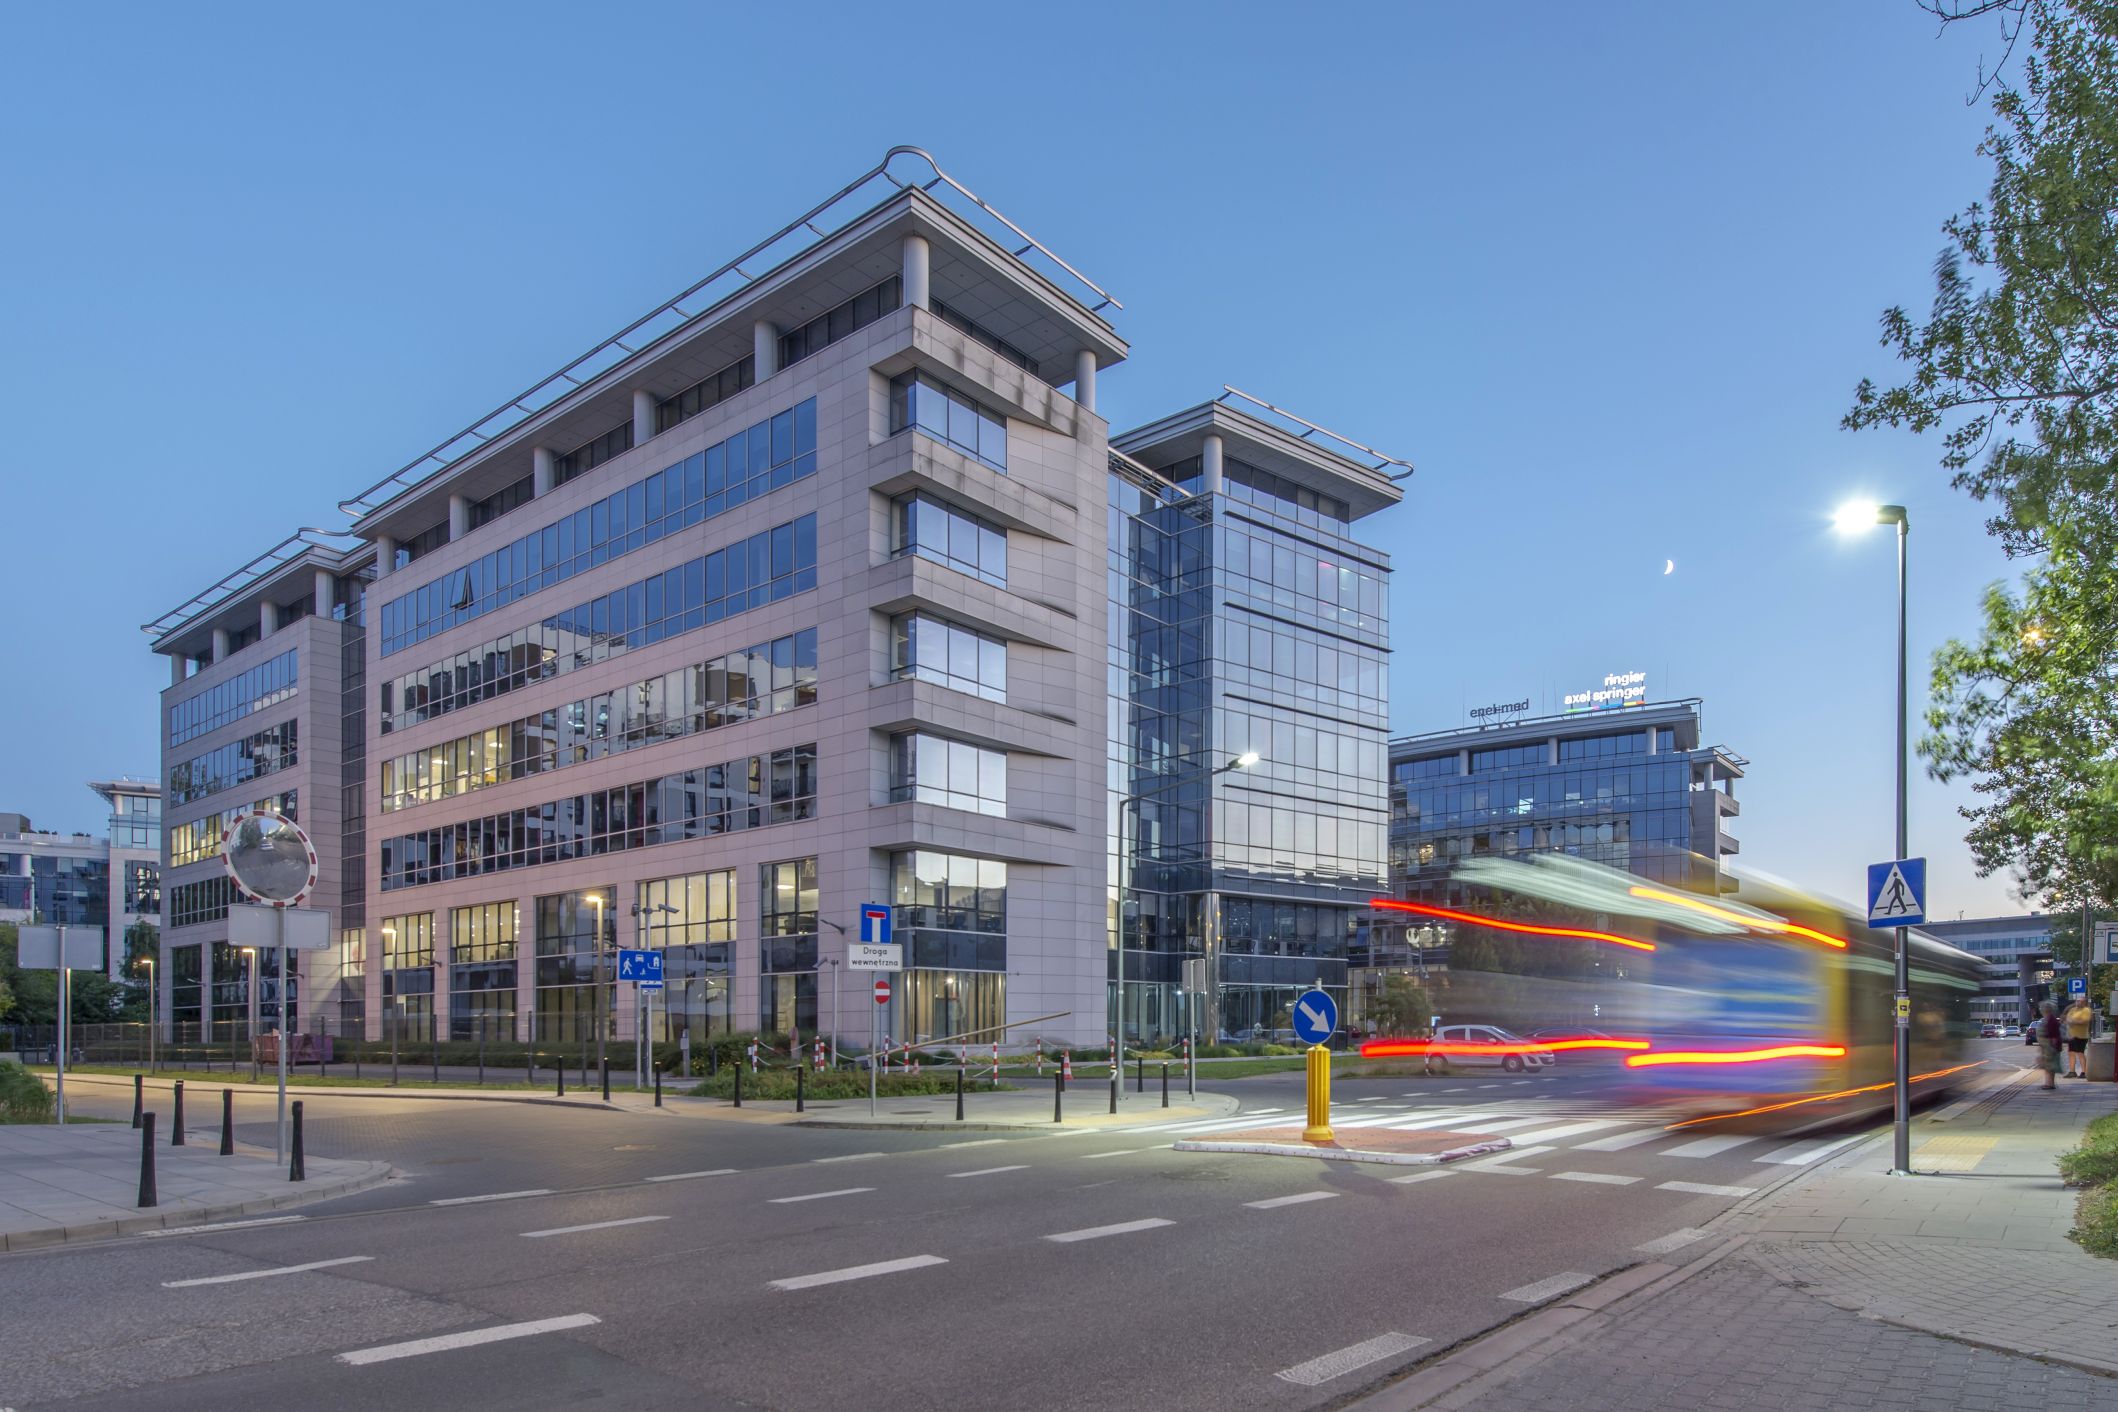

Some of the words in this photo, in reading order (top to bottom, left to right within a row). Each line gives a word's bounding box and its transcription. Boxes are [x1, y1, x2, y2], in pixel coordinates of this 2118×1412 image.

[1604, 671, 1646, 687] ringier
[1564, 690, 1591, 704] axel
[1592, 686, 1646, 702] springer
[1470, 698, 1529, 718] enel-med
[863, 946, 888, 956] Droga
[851, 958, 899, 968] wewnętrzna
[2072, 980, 2083, 992] P
